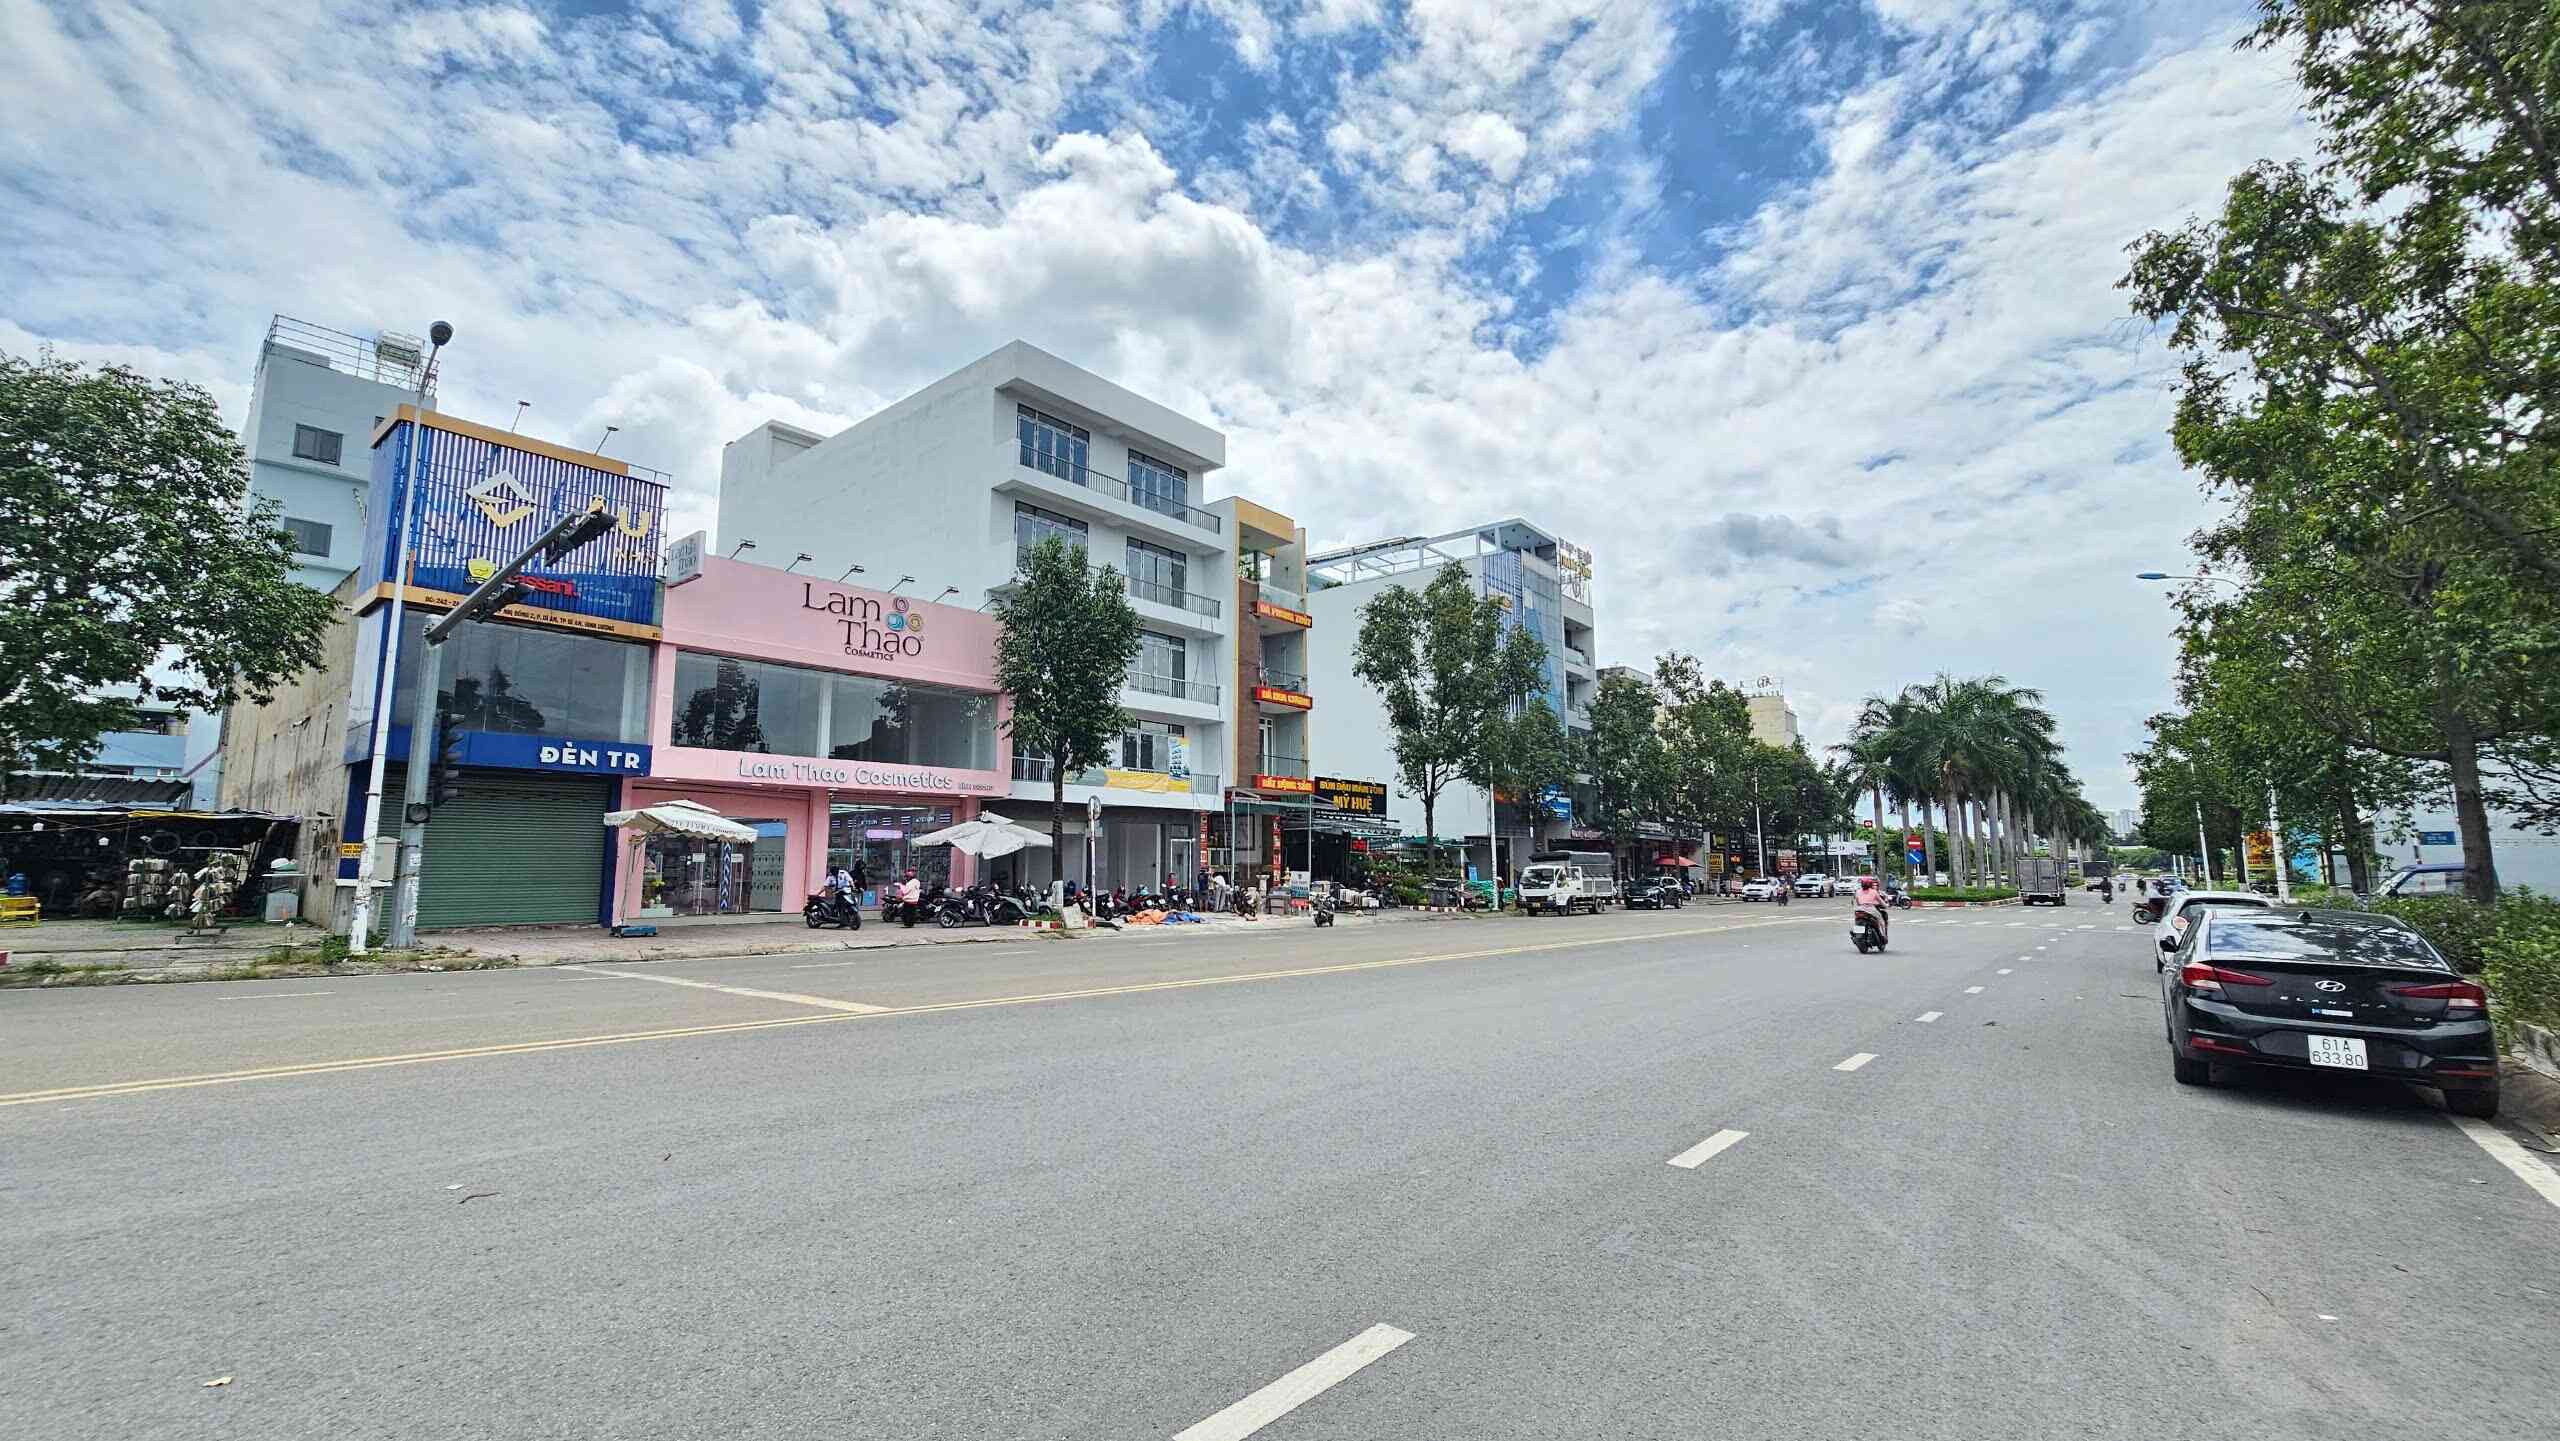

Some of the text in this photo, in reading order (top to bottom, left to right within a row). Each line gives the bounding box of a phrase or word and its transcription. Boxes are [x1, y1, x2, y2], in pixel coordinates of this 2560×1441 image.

[802, 582, 881, 622] Lam
[837, 618, 922, 657] Thao
[540, 741, 640, 769] ĐÈN TR
[739, 758, 788, 779] Lam
[793, 763, 849, 784] Thao
[855, 767, 953, 790] Cosmetics
[1351, 795, 1373, 813] HUỆ
[2322, 1038, 2351, 1051] 61A
[2312, 1051, 2364, 1067] 633.80
